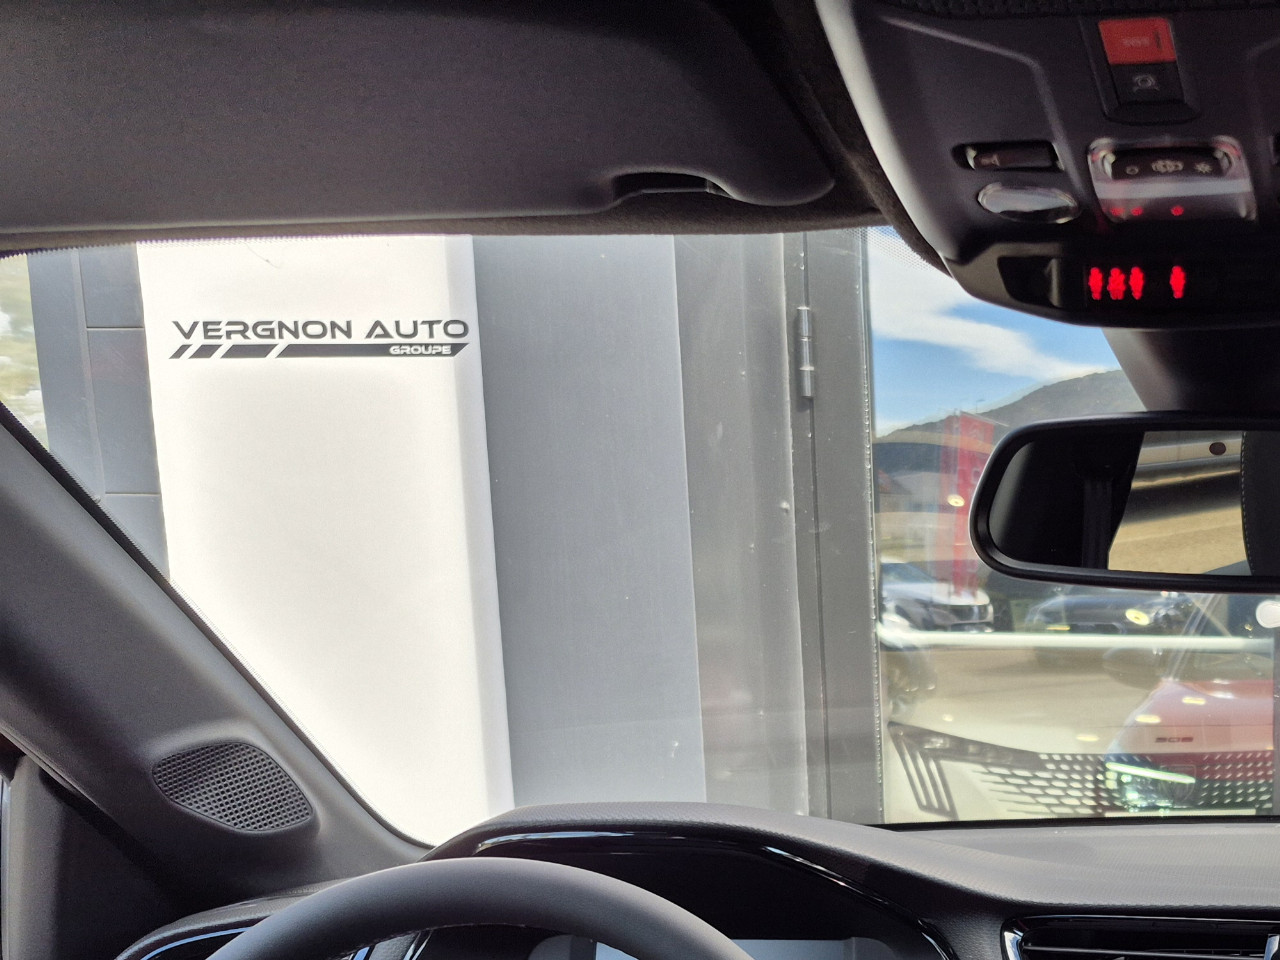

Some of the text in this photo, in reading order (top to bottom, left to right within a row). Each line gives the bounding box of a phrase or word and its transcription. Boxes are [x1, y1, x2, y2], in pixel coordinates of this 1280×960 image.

[171, 319, 470, 340] VERGNON AUTO
[389, 344, 453, 356] GROUPE
